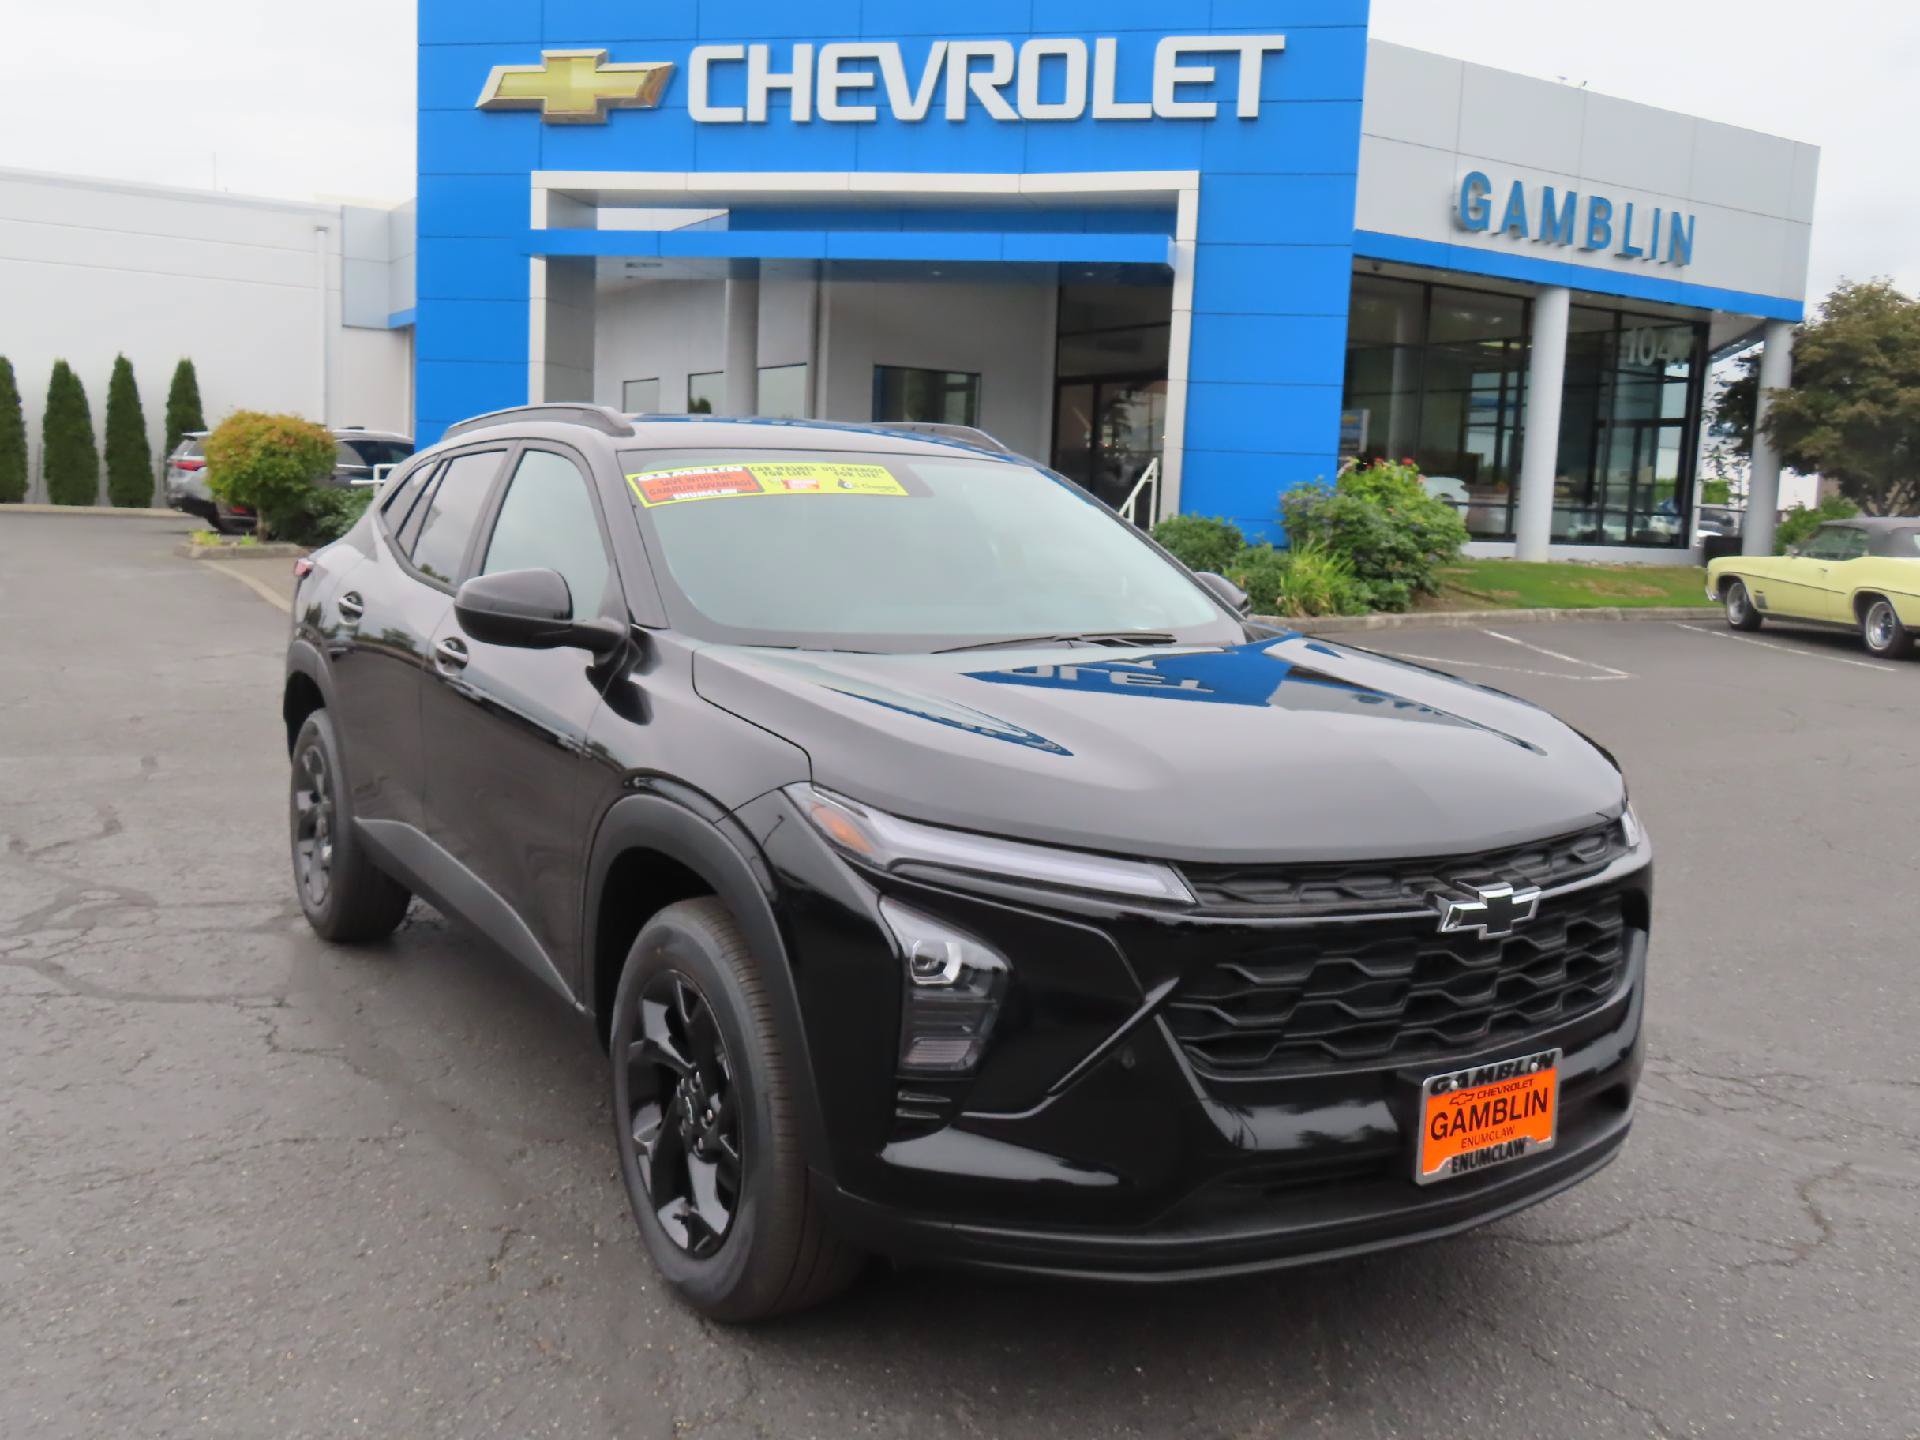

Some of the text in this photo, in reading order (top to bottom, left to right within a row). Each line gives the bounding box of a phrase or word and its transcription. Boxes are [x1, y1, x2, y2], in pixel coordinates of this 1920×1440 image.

[688, 35, 1285, 123] CHEVROLET
[1457, 171, 1695, 267] GAMBLIN
[1477, 1079, 1534, 1099] CHEVROLET
[1430, 1087, 1548, 1141] GAMBLIN
[1452, 1137, 1528, 1174] ENUMCLAW
[1461, 1126, 1516, 1149] ENUMCLAW
